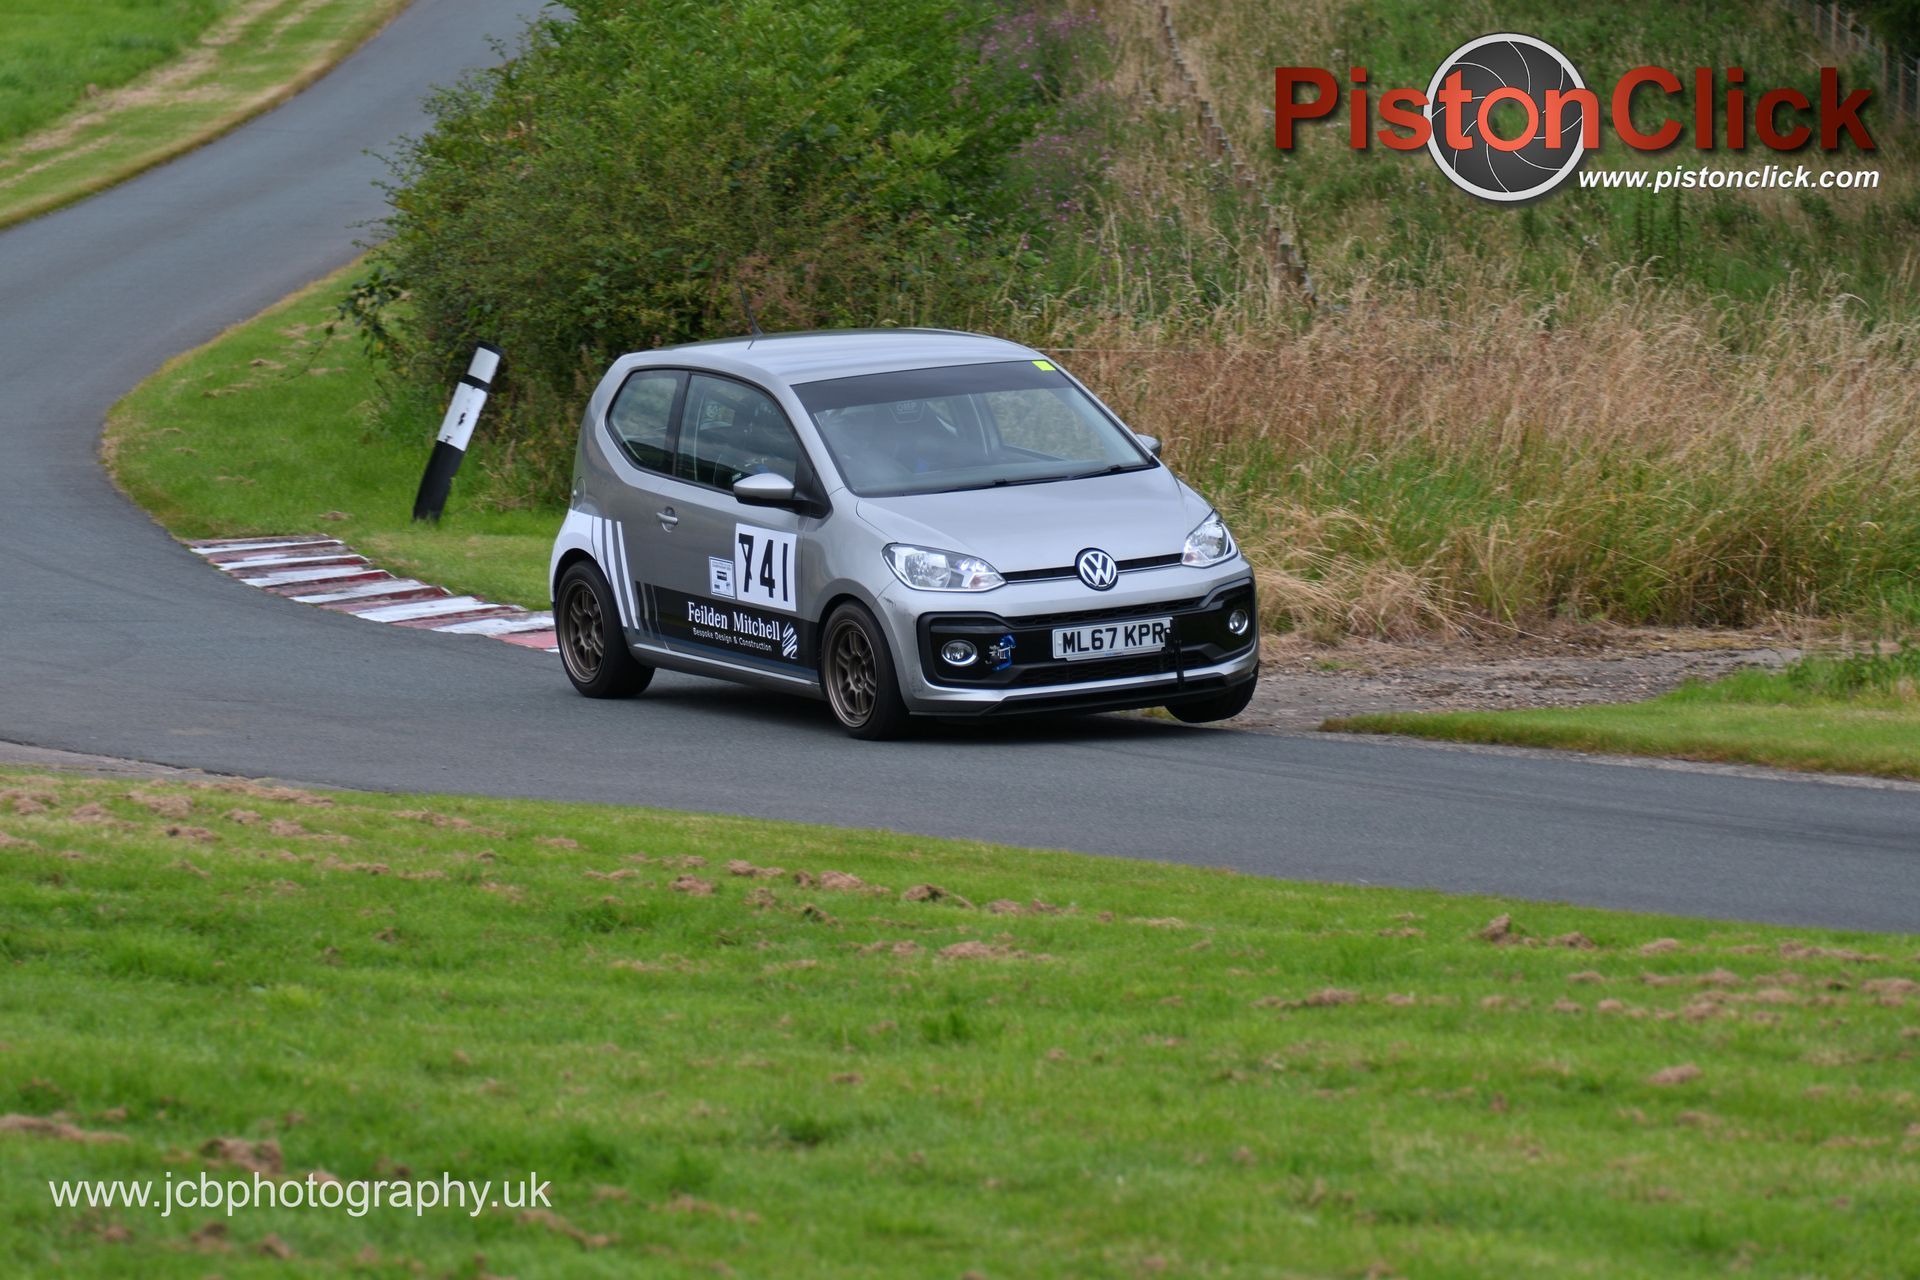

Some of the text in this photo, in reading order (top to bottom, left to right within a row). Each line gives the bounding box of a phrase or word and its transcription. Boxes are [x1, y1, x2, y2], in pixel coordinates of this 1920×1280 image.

[738, 533, 788, 601] 741
[688, 602, 780, 640] Feilden Mitchell
[1062, 622, 1165, 653] ML67 KPR
[693, 628, 772, 651] Bespoke Design & Construction
